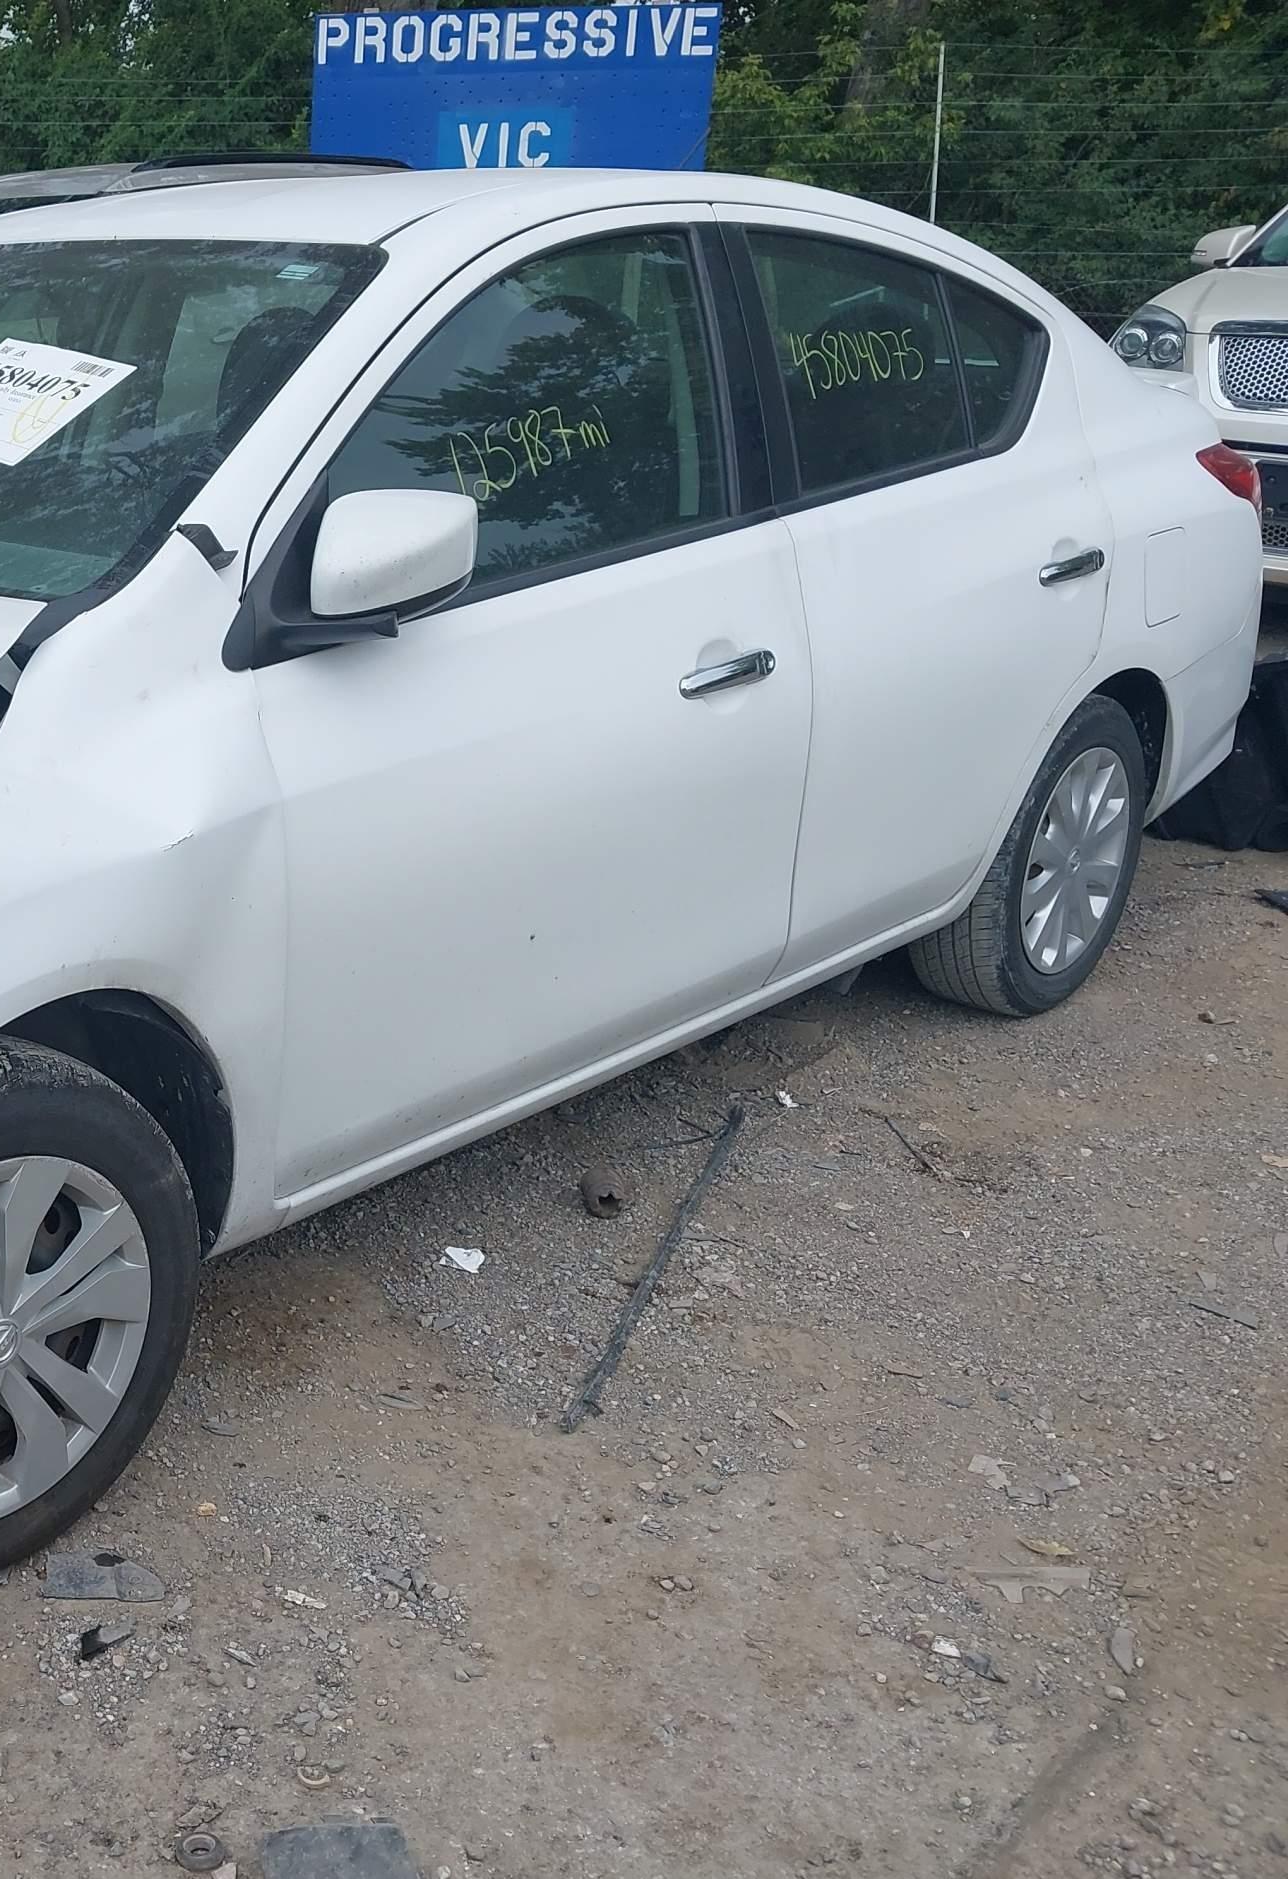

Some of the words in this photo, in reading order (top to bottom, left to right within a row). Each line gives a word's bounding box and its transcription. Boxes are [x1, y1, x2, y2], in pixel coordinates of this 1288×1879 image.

[318, 8, 718, 65] PROGRESSIVE
[459, 121, 551, 168] VIC
[790, 328, 924, 399] 45804075
